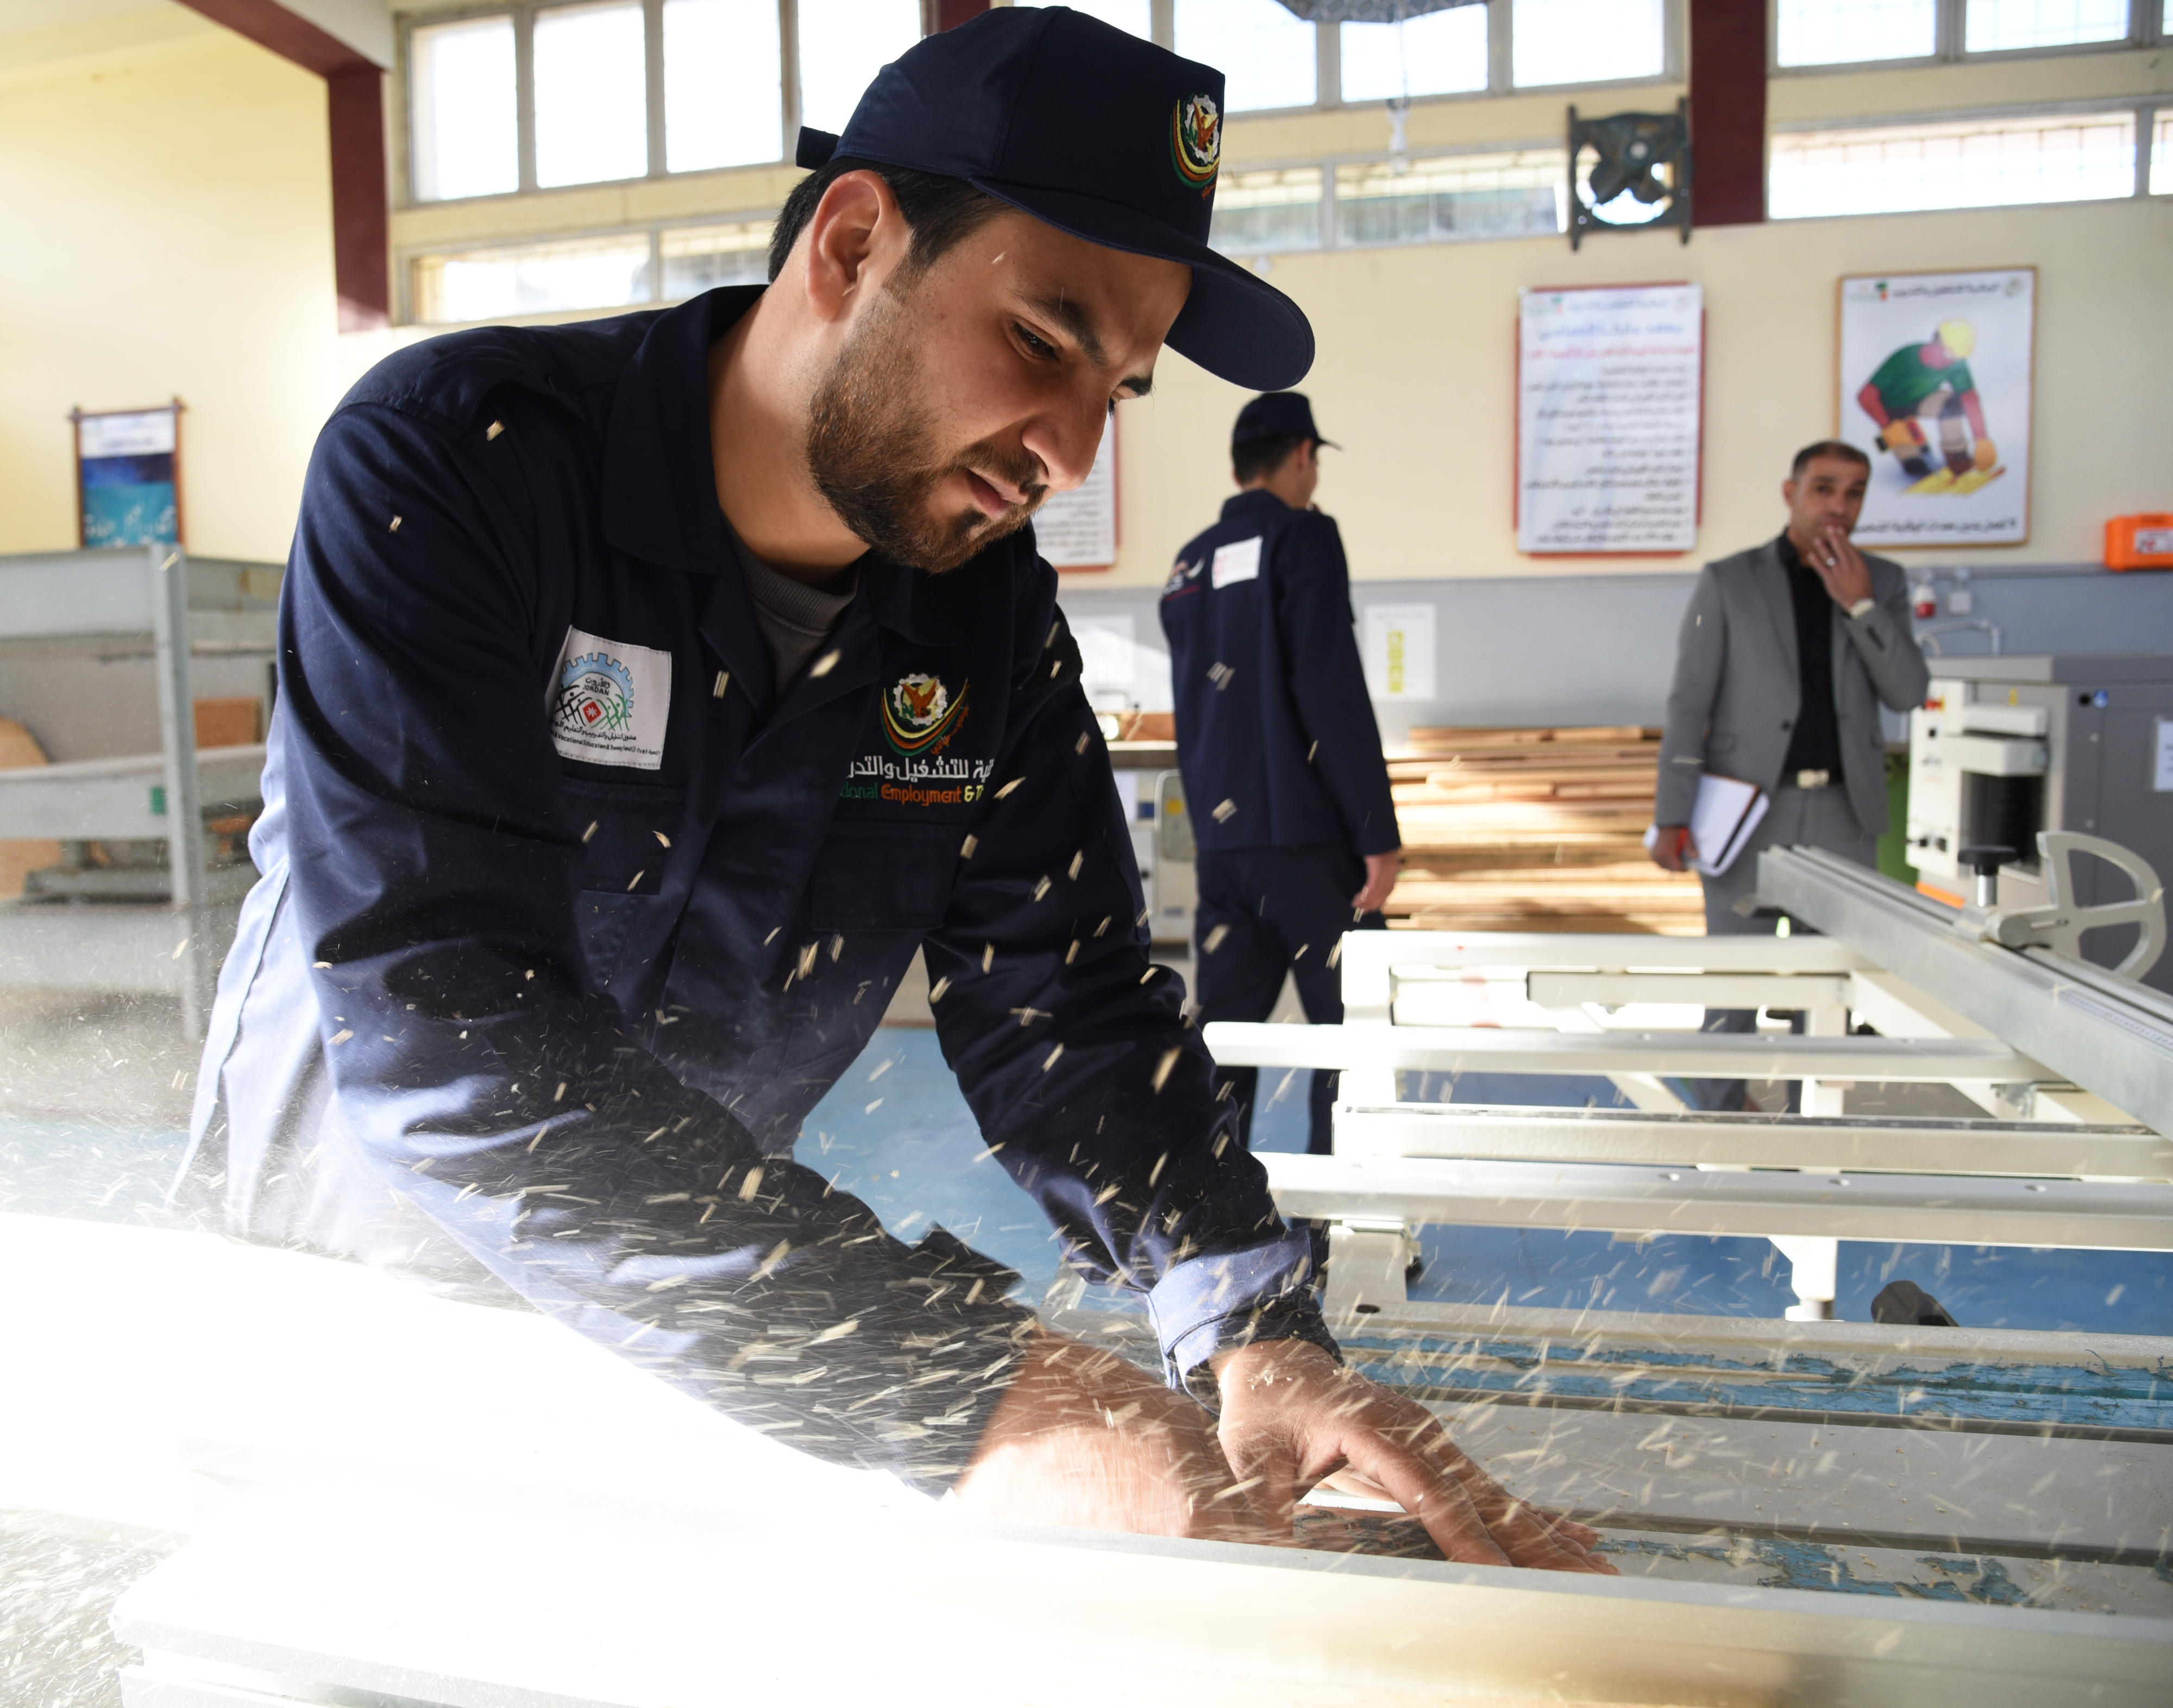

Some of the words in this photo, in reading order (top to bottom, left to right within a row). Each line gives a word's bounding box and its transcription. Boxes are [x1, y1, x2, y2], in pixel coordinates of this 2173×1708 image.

[583, 683, 609, 695] JORDAN
[558, 732, 583, 745] Vocational
[897, 755, 969, 783] للتشغيل
[881, 783, 963, 807] Employment
[964, 785, 975, 802] &
